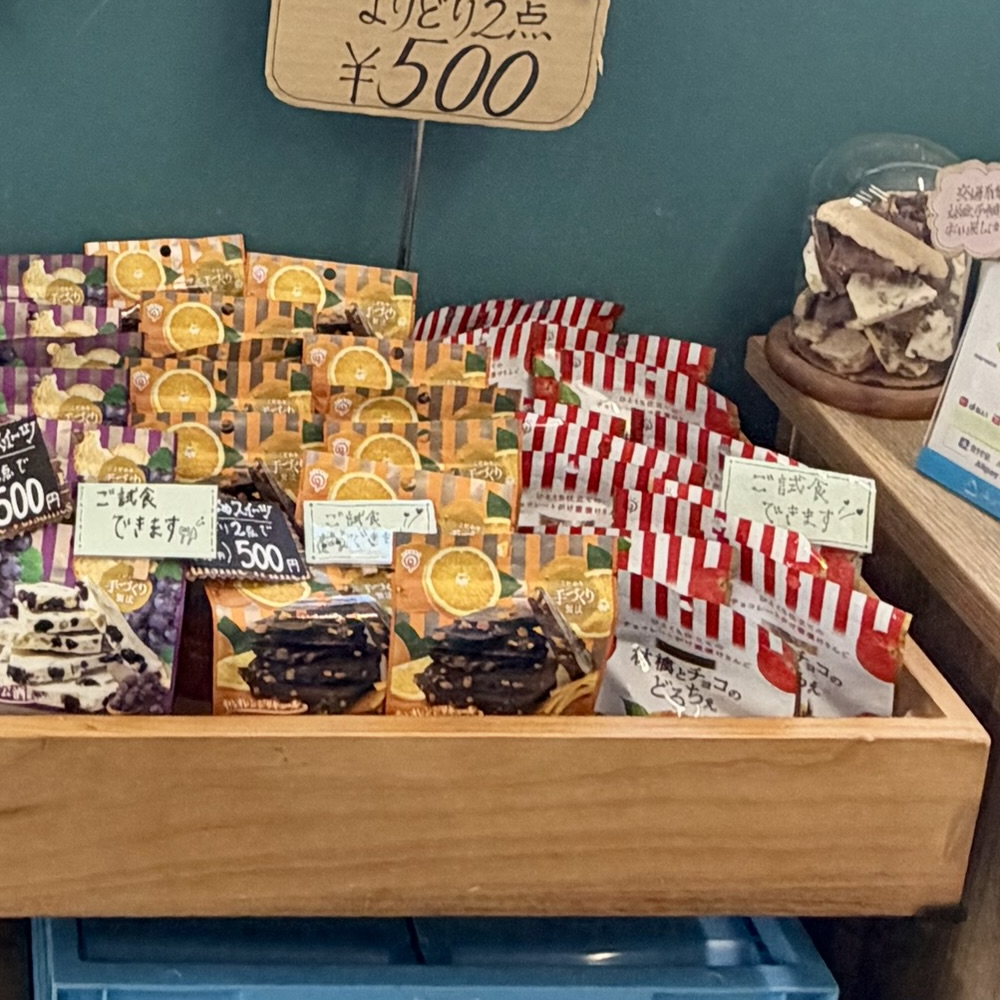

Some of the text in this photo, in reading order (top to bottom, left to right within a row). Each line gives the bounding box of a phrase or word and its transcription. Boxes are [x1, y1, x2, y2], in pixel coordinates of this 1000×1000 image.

[339, 36, 540, 118] ¥500
[95, 486, 157, 510] ご試食
[752, 473, 829, 504] ご試食
[112, 515, 181, 543] できます
[762, 501, 835, 532] できます
[234, 539, 301, 573] 500円
